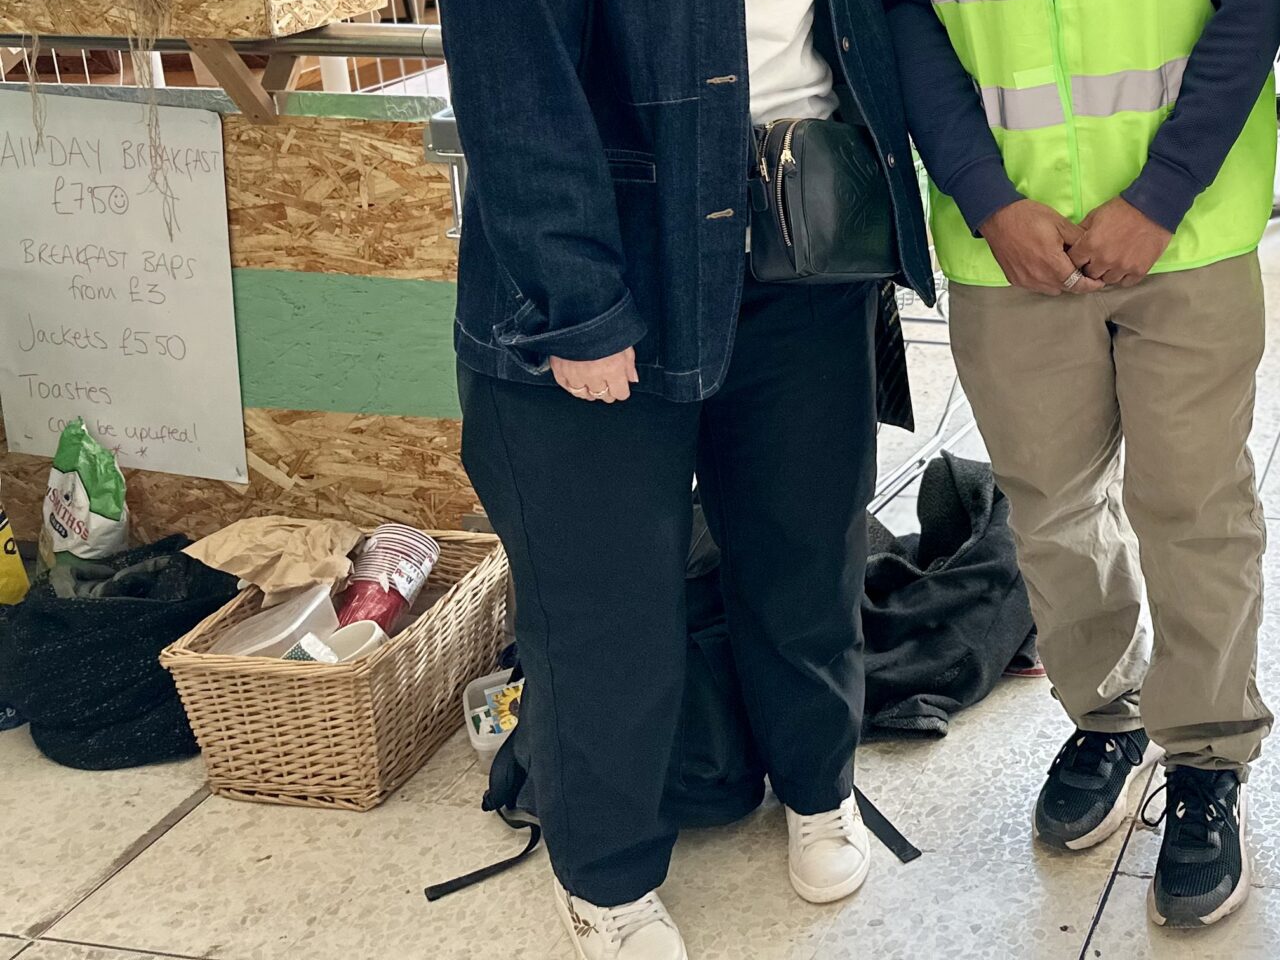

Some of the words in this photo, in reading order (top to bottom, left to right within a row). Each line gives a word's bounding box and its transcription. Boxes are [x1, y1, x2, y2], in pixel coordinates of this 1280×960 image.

[46, 135, 102, 174] DAY
[121, 140, 220, 182] BRAKFAST
[142, 250, 197, 280] BAPS
[68, 274, 117, 301] from
[129, 276, 167, 305] £3
[18, 312, 108, 353] Jackets
[18, 373, 112, 405] Toasties
[48, 416, 67, 433] ca
[96, 419, 116, 437] be
